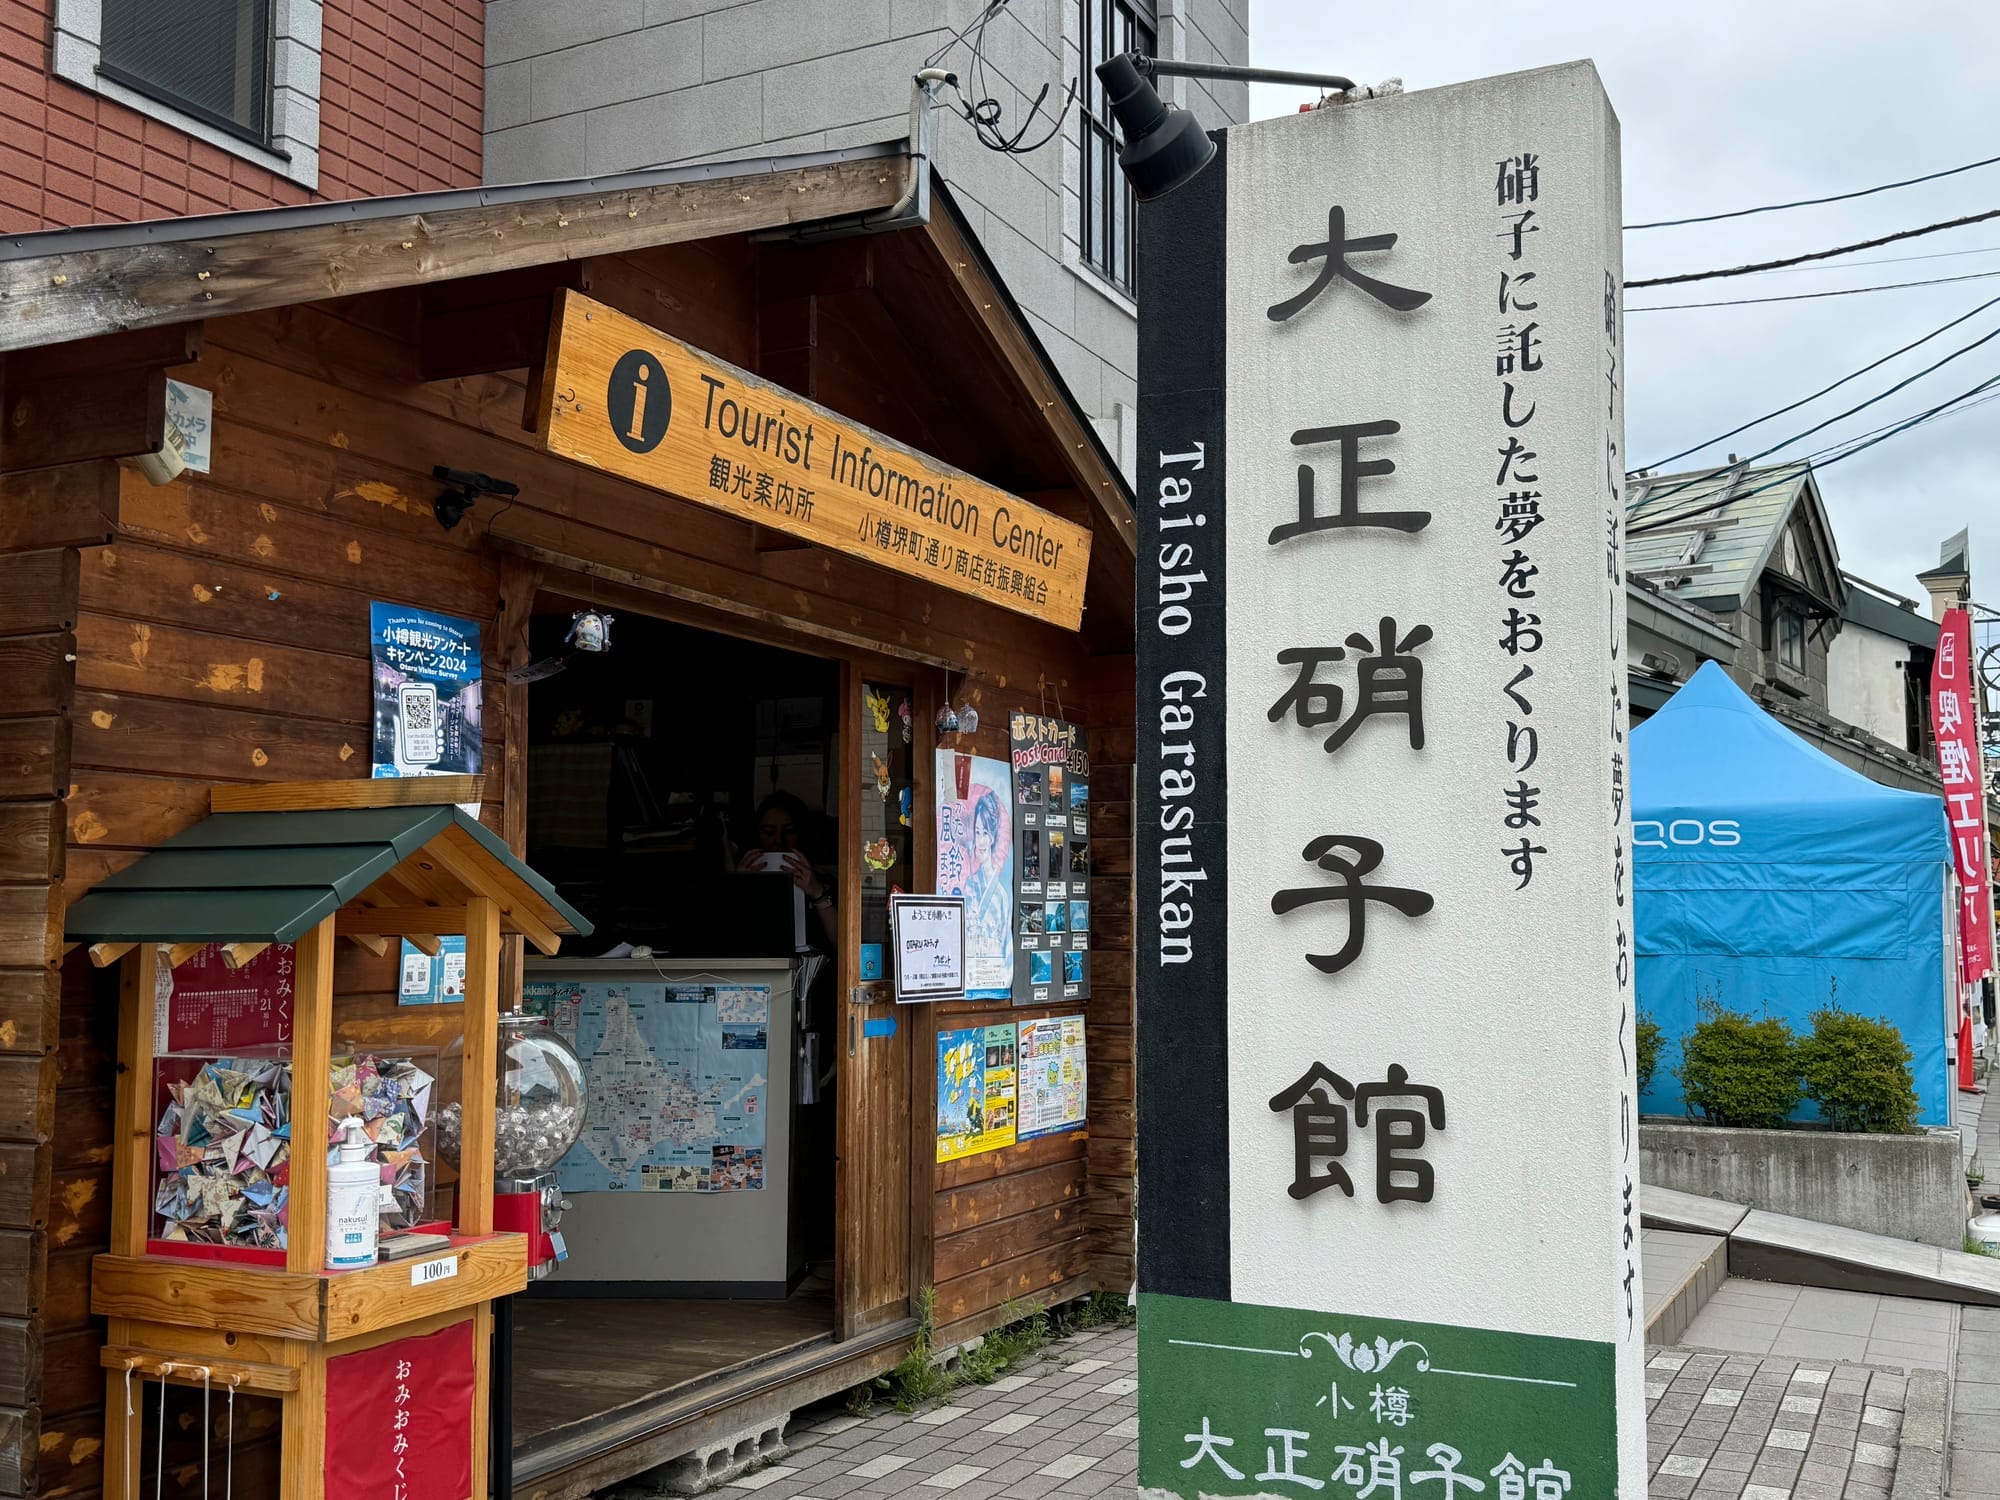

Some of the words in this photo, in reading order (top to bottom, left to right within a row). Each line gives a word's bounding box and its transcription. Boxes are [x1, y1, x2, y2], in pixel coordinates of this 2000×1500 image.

[700, 373, 814, 471] Tourist
[830, 433, 980, 537] Information
[992, 507, 1064, 571] Center
[708, 453, 816, 523] 観光案内所
[857, 511, 1049, 607] 小樽堺町通り商店街振興組合
[1158, 441, 1208, 636] Taisho
[1494, 153, 1548, 891] 硝子に託した夢をおくります
[382, 625, 472, 657] 小樽観光アンケート
[386, 645, 467, 673] キャンペーン2024
[399, 662, 418, 673] Otaru
[418, 665, 438, 676] Visitor
[438, 669, 458, 681] Survey
[1012, 715, 1076, 748] ポストカード
[1267, 205, 1446, 1205] 大正硝子館
[1012, 740, 1041, 773] Post
[1040, 740, 1067, 763] Card
[1065, 748, 1090, 777] ¥150
[1158, 669, 1209, 967] Garasukan
[423, 1261, 451, 1280] 100円
[393, 1359, 412, 1500] おみおみくじ
[1315, 1382, 1415, 1427] 小樽
[1180, 1416, 1572, 1500] 大正硝子館
